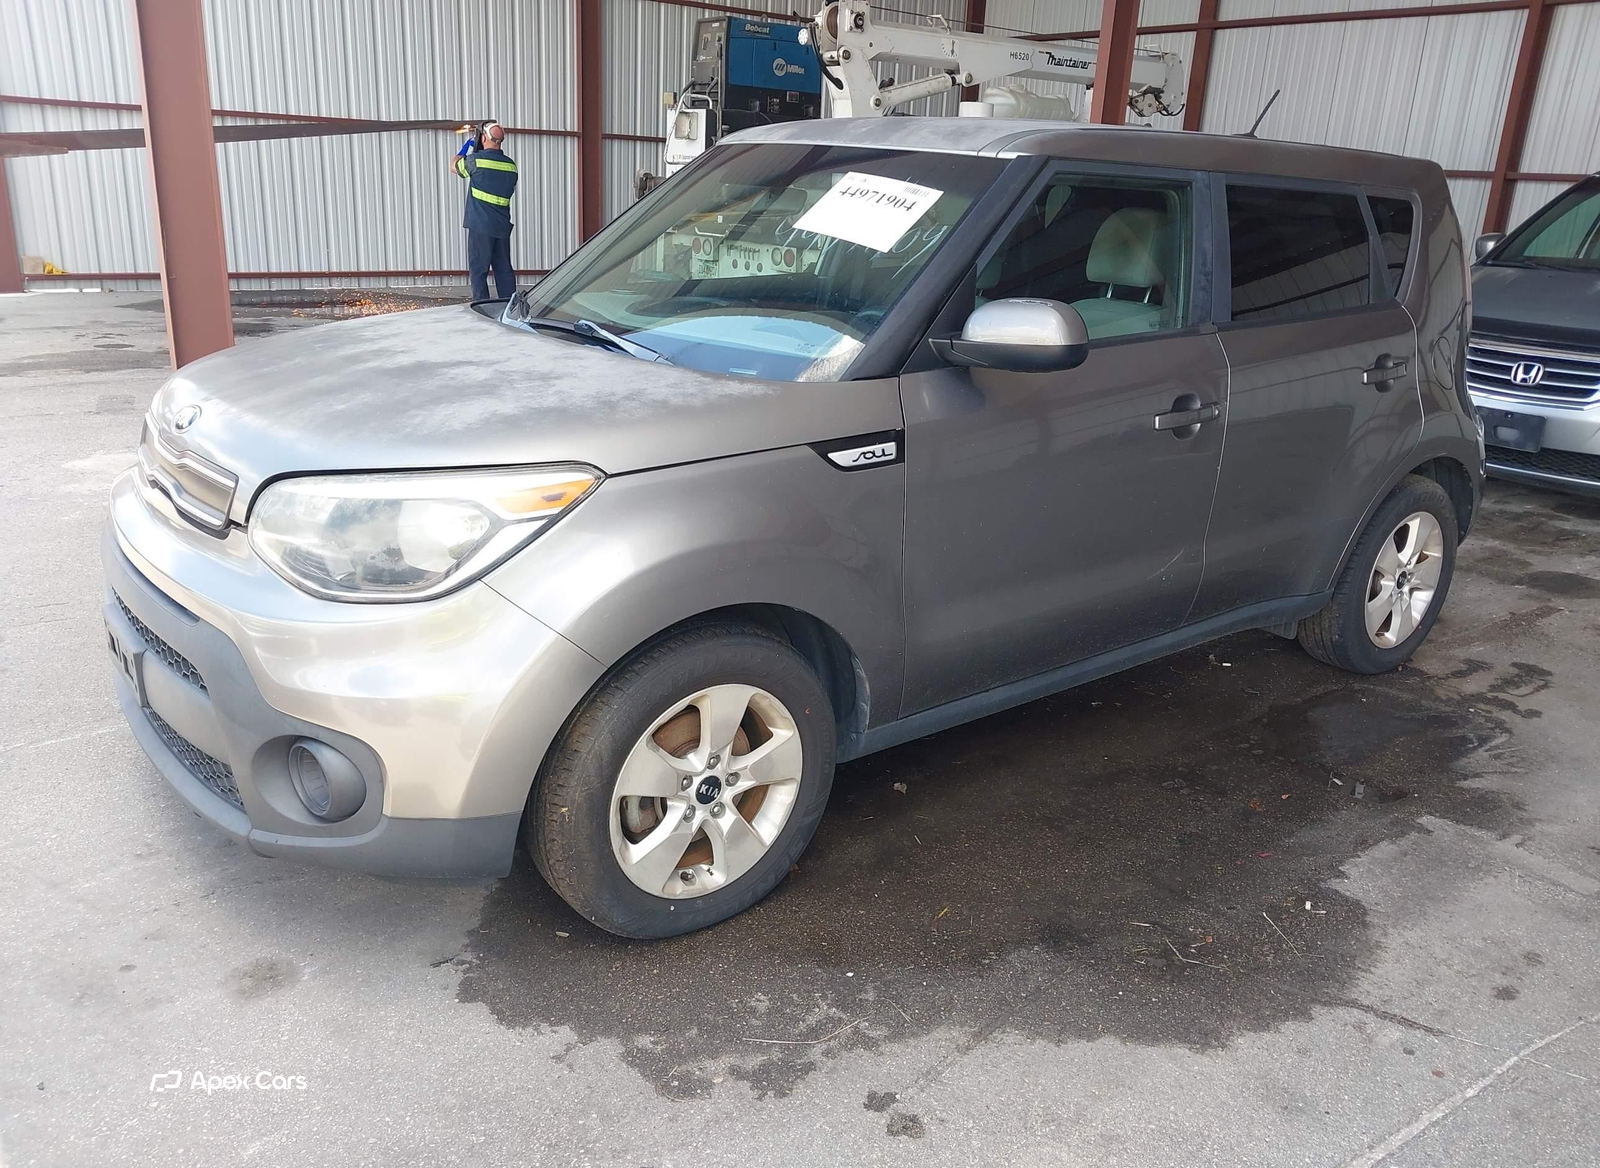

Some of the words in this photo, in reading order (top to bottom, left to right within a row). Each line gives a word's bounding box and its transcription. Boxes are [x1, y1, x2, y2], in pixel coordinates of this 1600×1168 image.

[744, 23, 770, 34] Bobcat
[1009, 51, 1029, 61] H6520
[1045, 51, 1092, 69] Maintainer
[787, 64, 805, 75] Miller
[839, 186, 918, 212] 44971904
[699, 784, 718, 798] KIA
